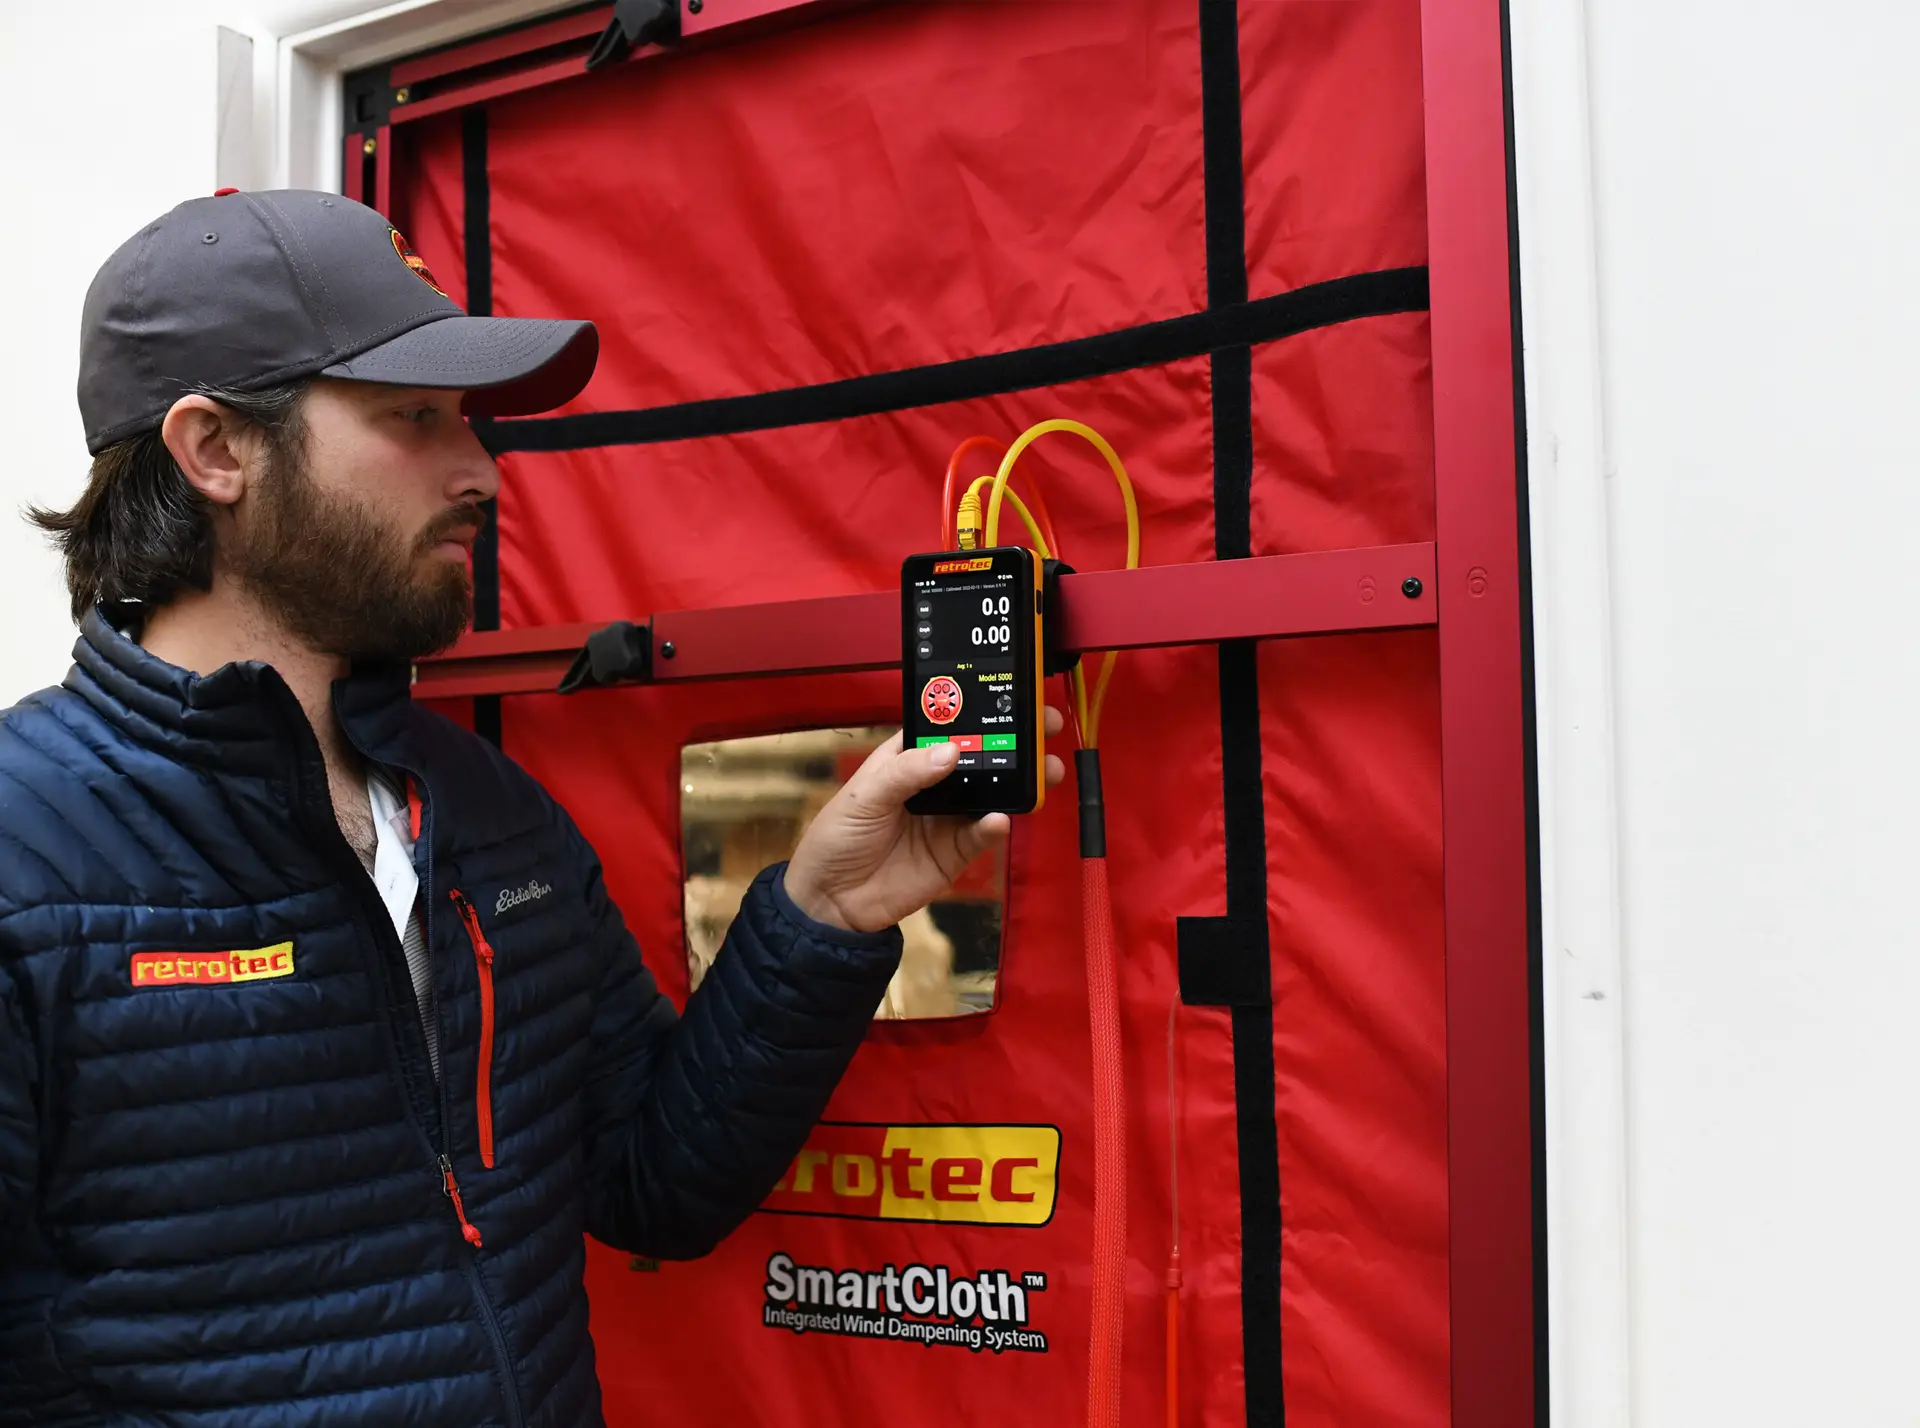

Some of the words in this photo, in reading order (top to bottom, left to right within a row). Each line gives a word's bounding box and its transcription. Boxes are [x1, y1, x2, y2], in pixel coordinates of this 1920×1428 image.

[934, 559, 991, 573] retrotec
[982, 596, 1010, 616] 0.0
[971, 625, 1010, 645] 0.00
[979, 673, 997, 682] Model
[998, 673, 1013, 681] 5000
[136, 951, 288, 981] retrotec
[773, 1147, 1038, 1203] rotec
[764, 1306, 841, 1331] Integrated
[843, 1315, 885, 1335] Wind
[888, 1319, 981, 1348] Dampening
[984, 1326, 1045, 1349] System
